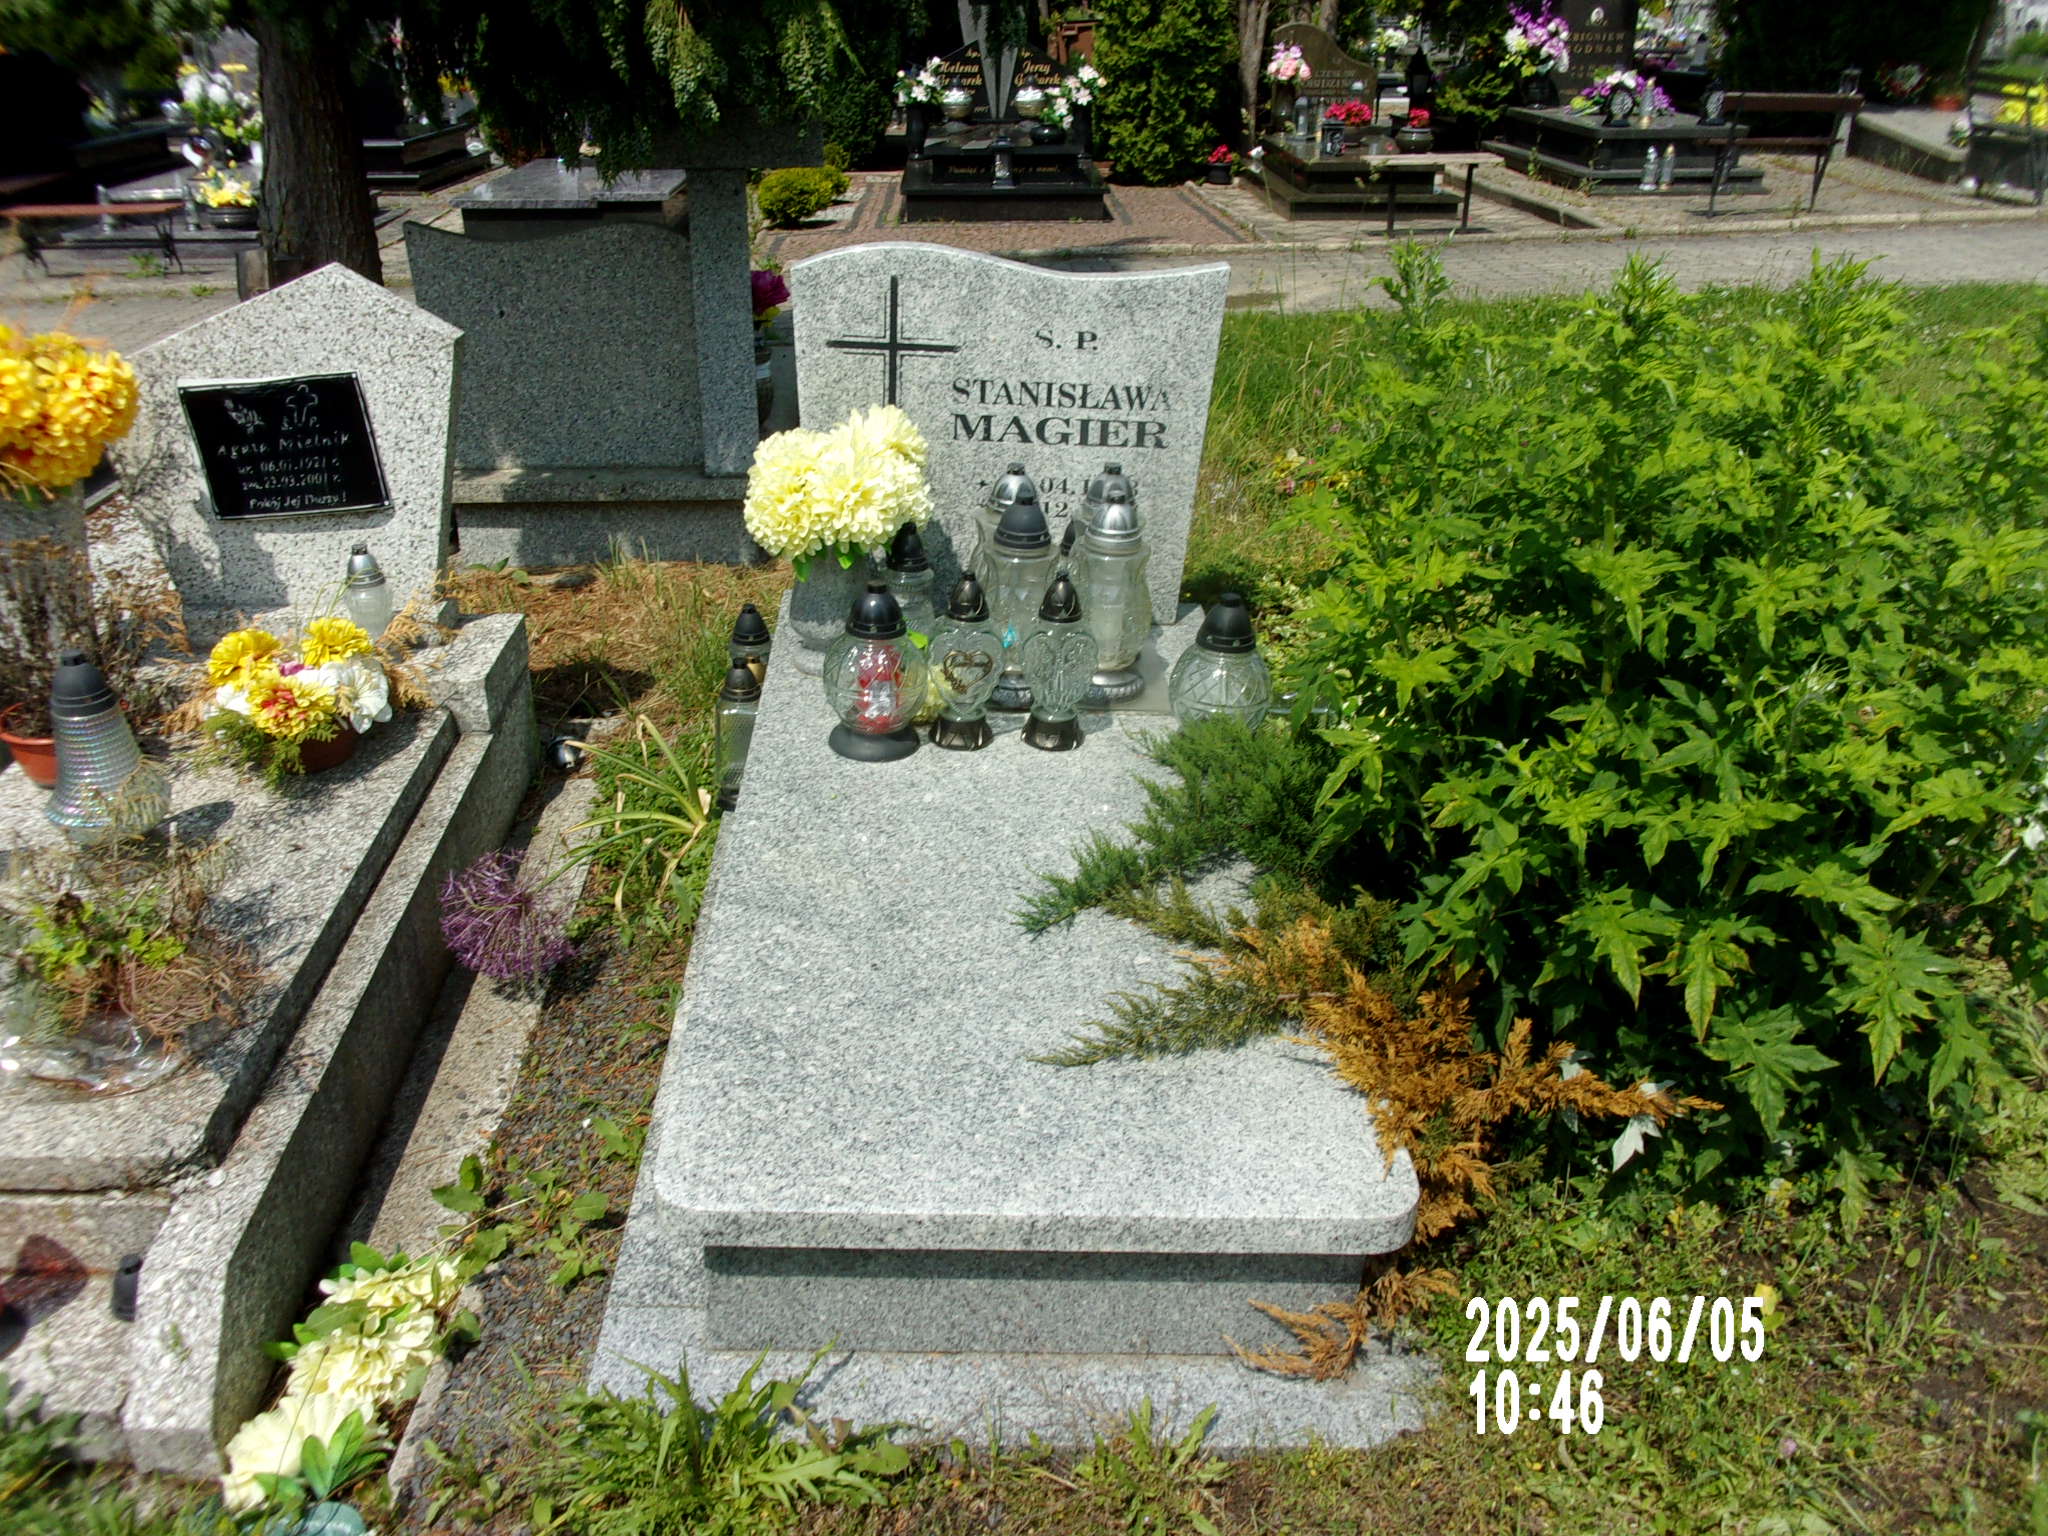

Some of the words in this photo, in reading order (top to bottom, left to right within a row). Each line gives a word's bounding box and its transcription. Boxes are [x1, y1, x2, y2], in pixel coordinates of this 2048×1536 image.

[1022, 60, 1051, 74] Jerzy
[1076, 331, 1099, 350] P.
[952, 379, 1173, 411] STANISŁAWA
[951, 413, 1168, 449] MAGIER
